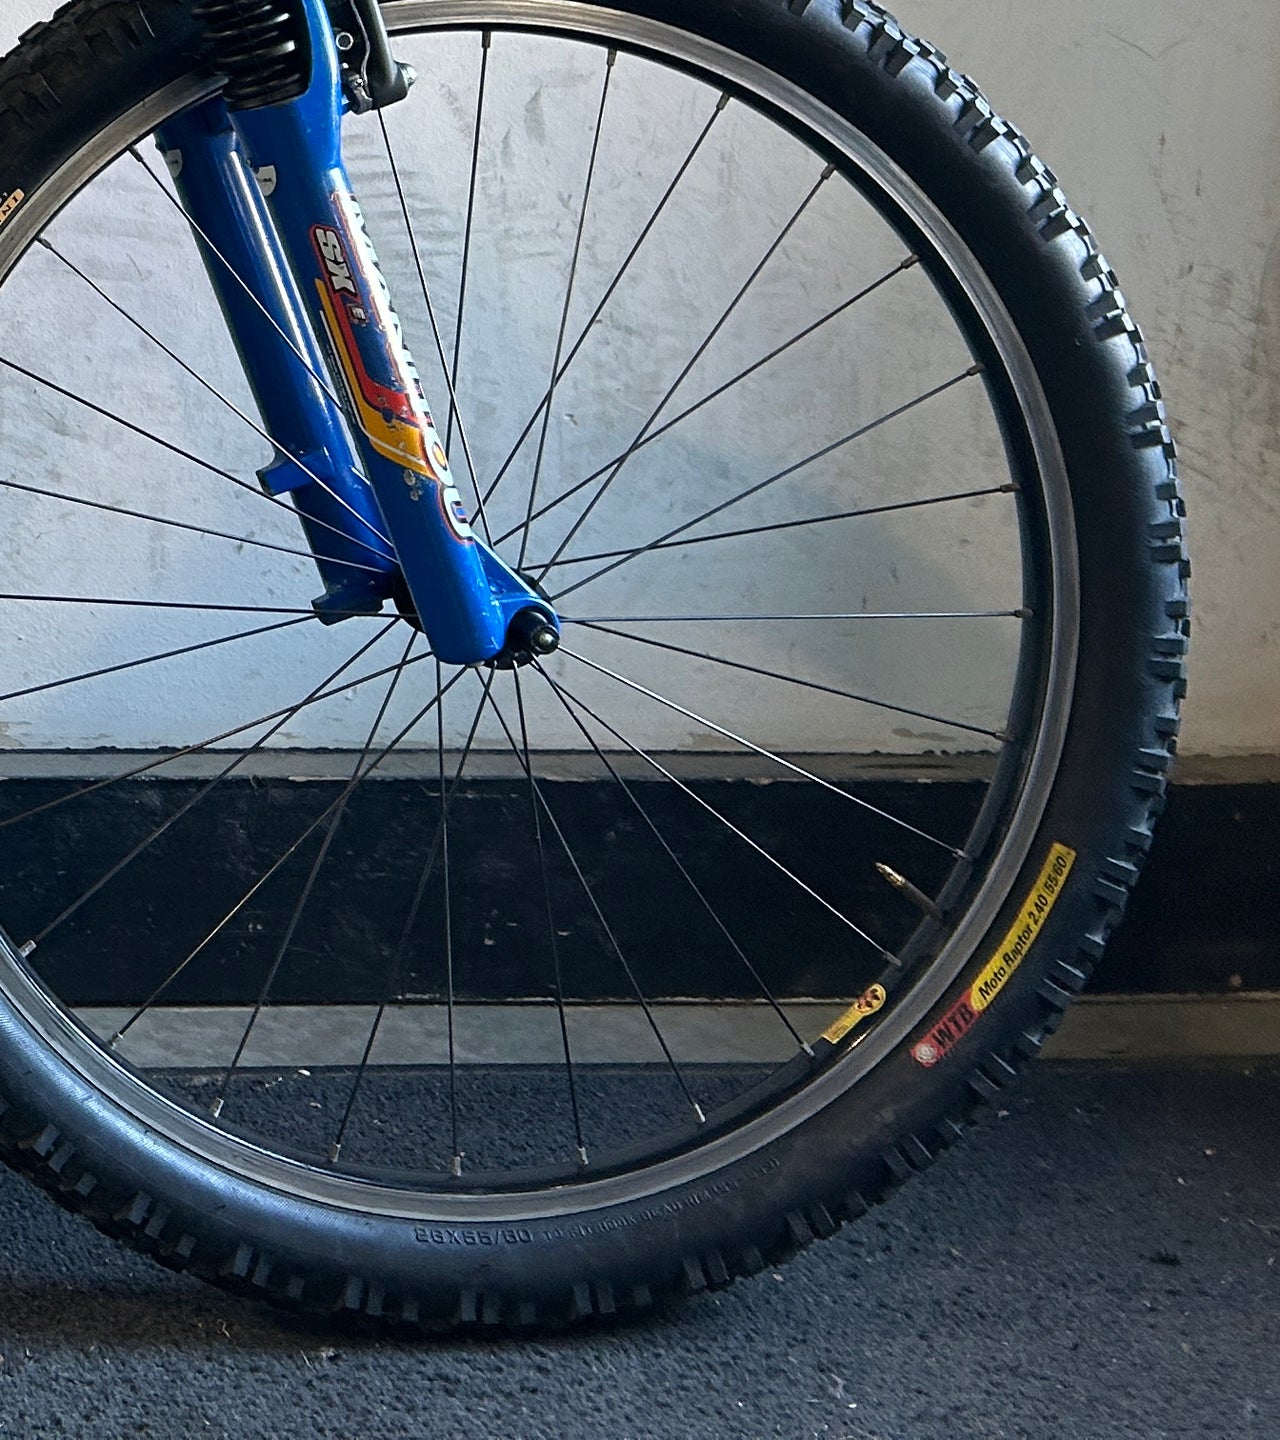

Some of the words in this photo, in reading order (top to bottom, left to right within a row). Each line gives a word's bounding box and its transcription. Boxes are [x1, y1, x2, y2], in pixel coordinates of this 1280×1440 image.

[315, 227, 357, 295] SX
[977, 965, 1008, 1002] Moto
[1002, 925, 1036, 968] Raptor
[1028, 894, 1050, 926] 2.40
[935, 1003, 977, 1053] WTB
